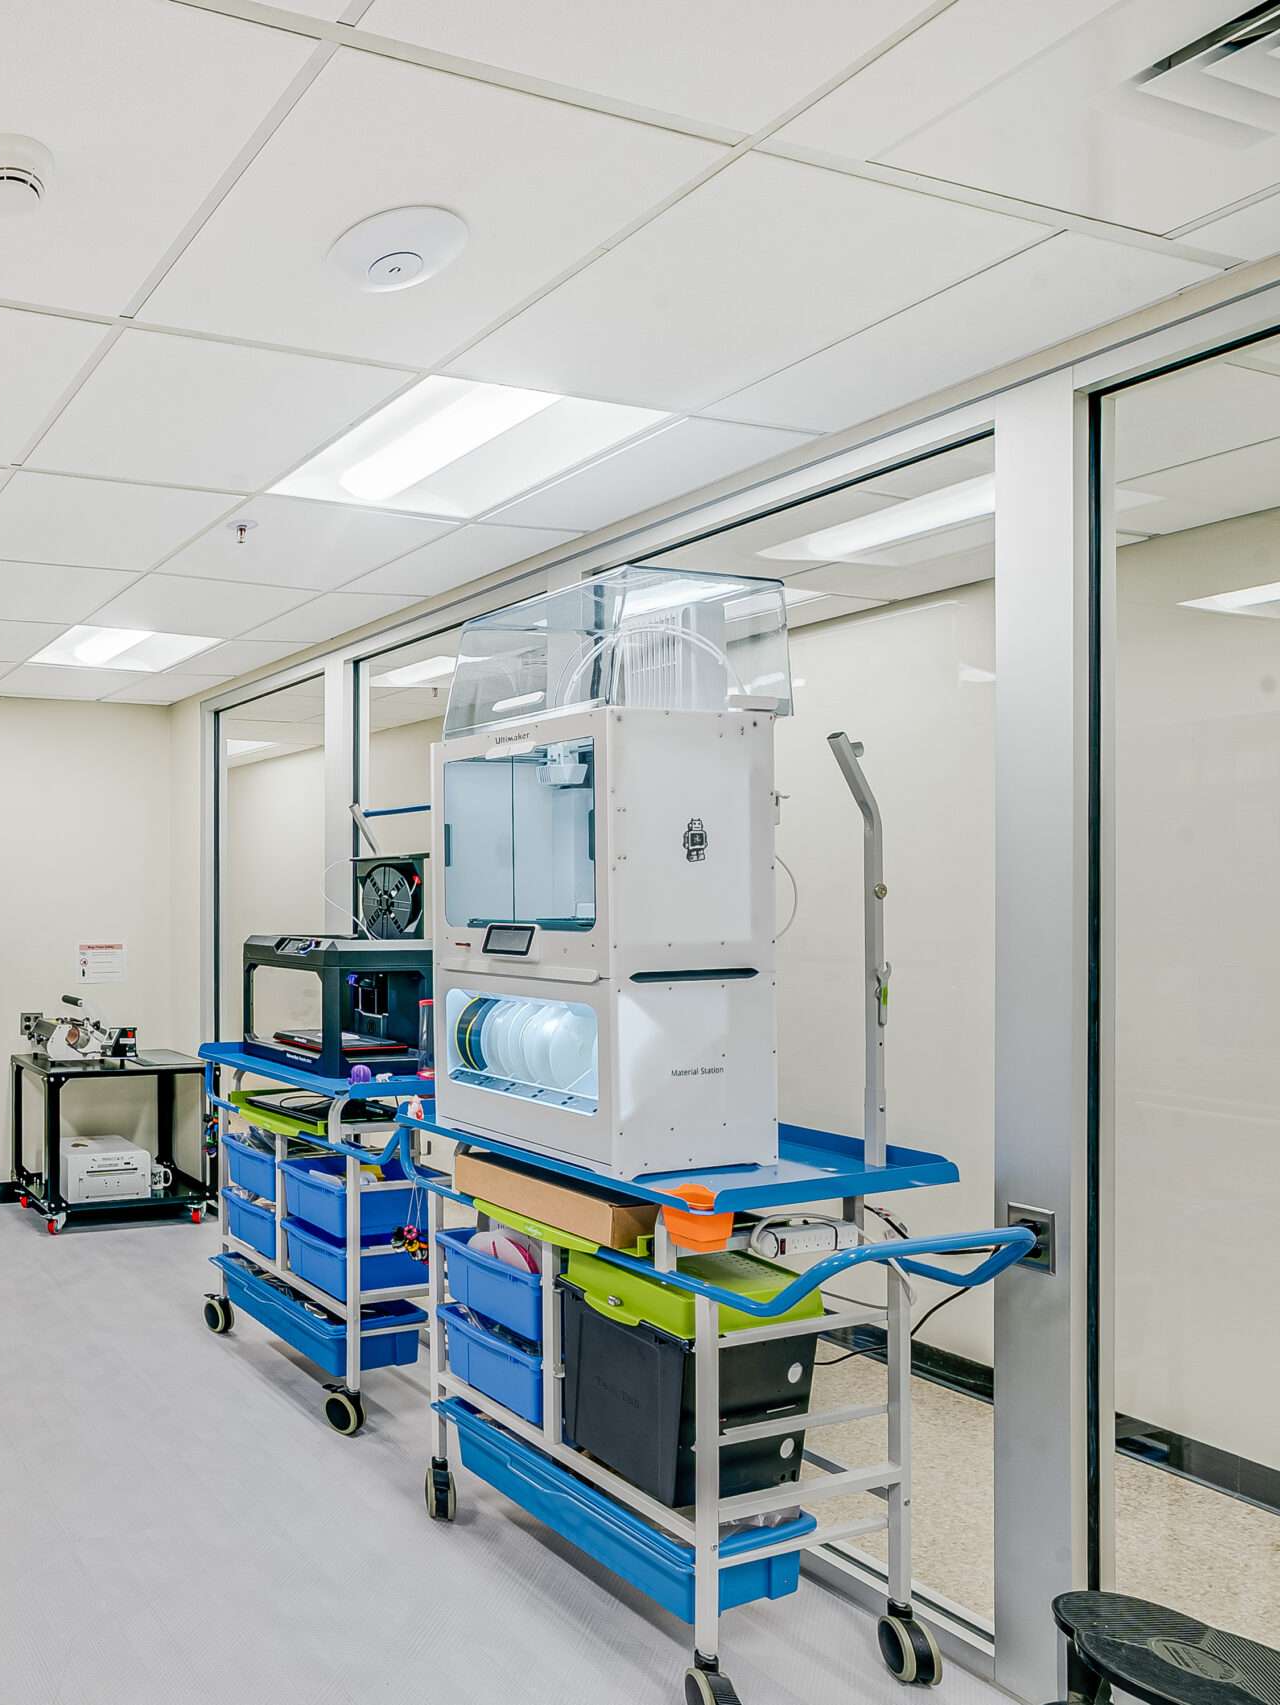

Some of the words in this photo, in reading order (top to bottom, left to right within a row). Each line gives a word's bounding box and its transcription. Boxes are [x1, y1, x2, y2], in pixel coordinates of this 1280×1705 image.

[495, 732, 529, 744] Ultimaker
[671, 1067, 698, 1076] Material
[700, 1066, 724, 1074] Station
